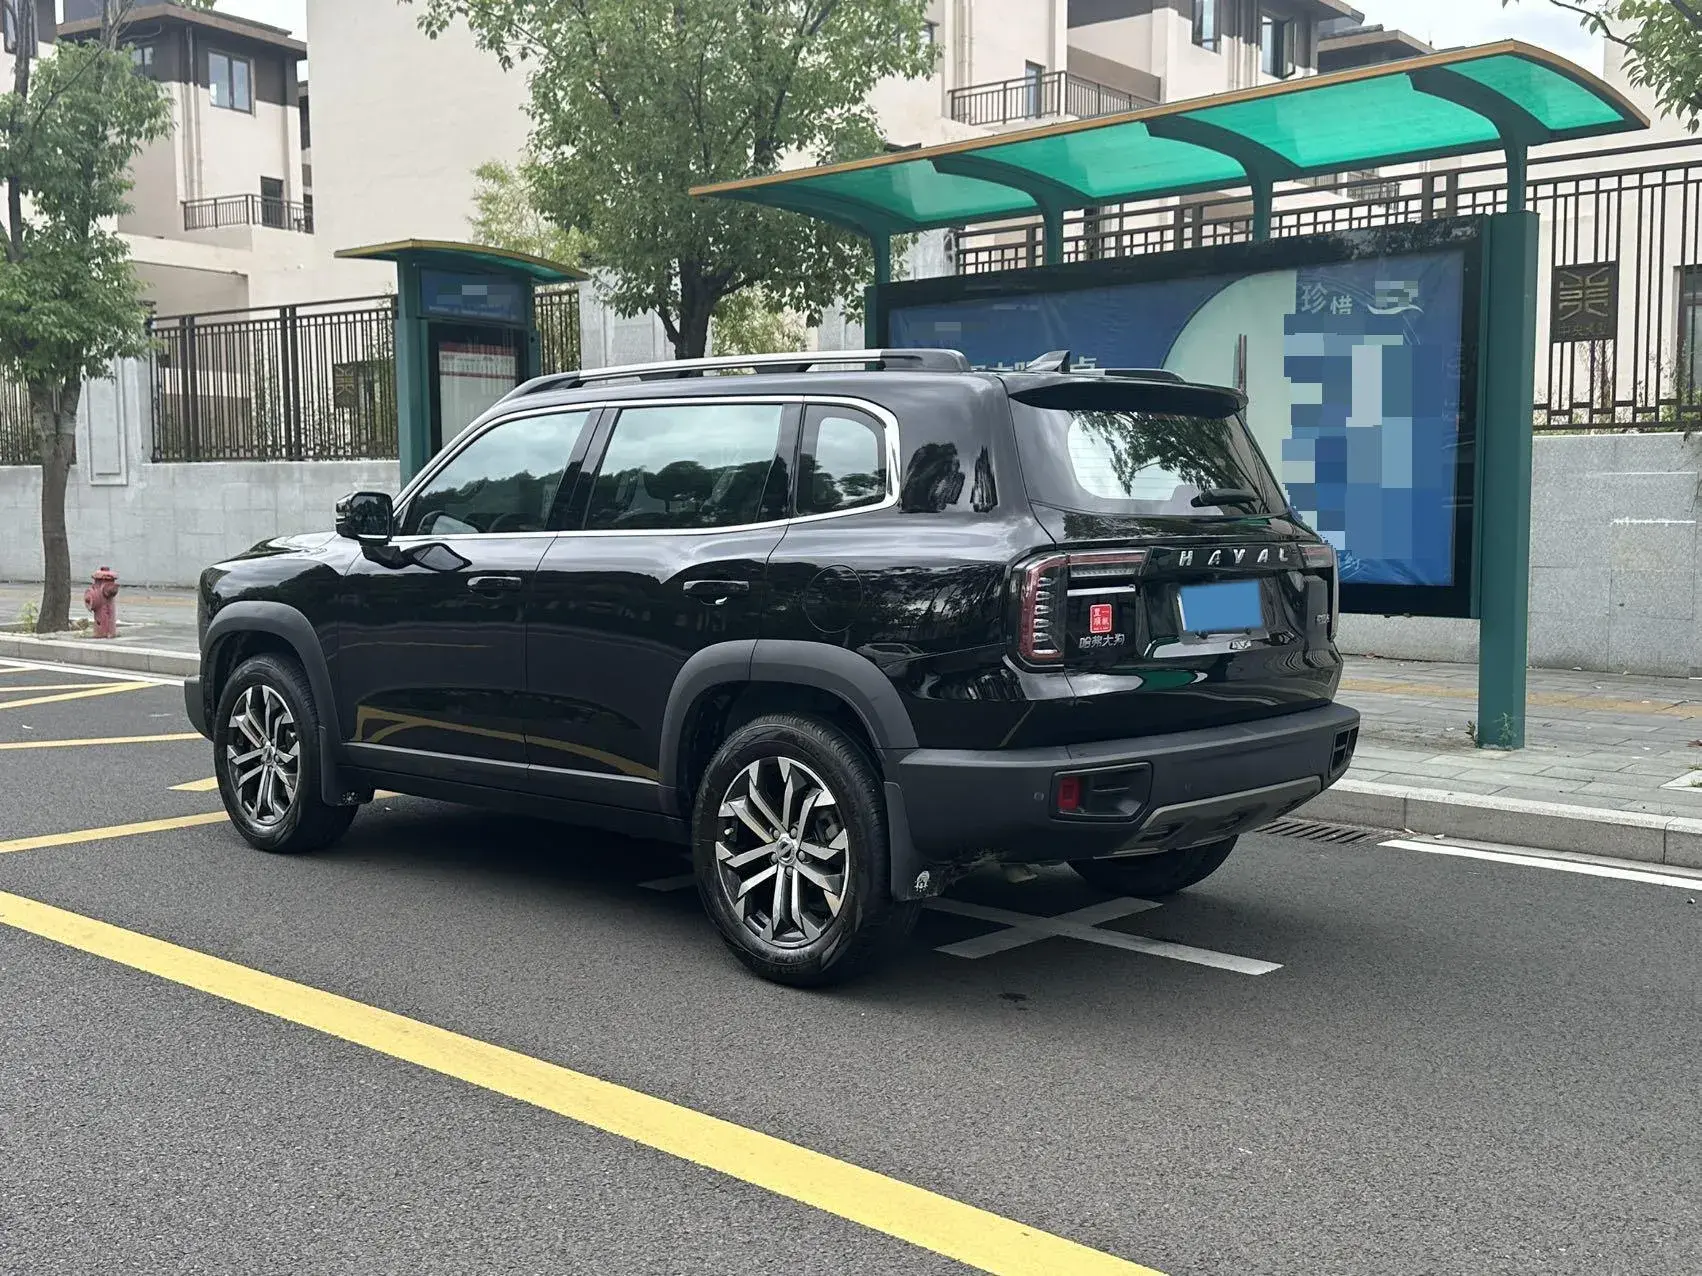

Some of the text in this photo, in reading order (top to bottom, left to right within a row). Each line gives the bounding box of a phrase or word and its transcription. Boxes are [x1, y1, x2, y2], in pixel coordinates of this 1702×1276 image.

[1301, 282, 1353, 315] 珍惜
[1178, 547, 1289, 567] HAVAL
[1078, 633, 1125, 649] 哈弗大狗
